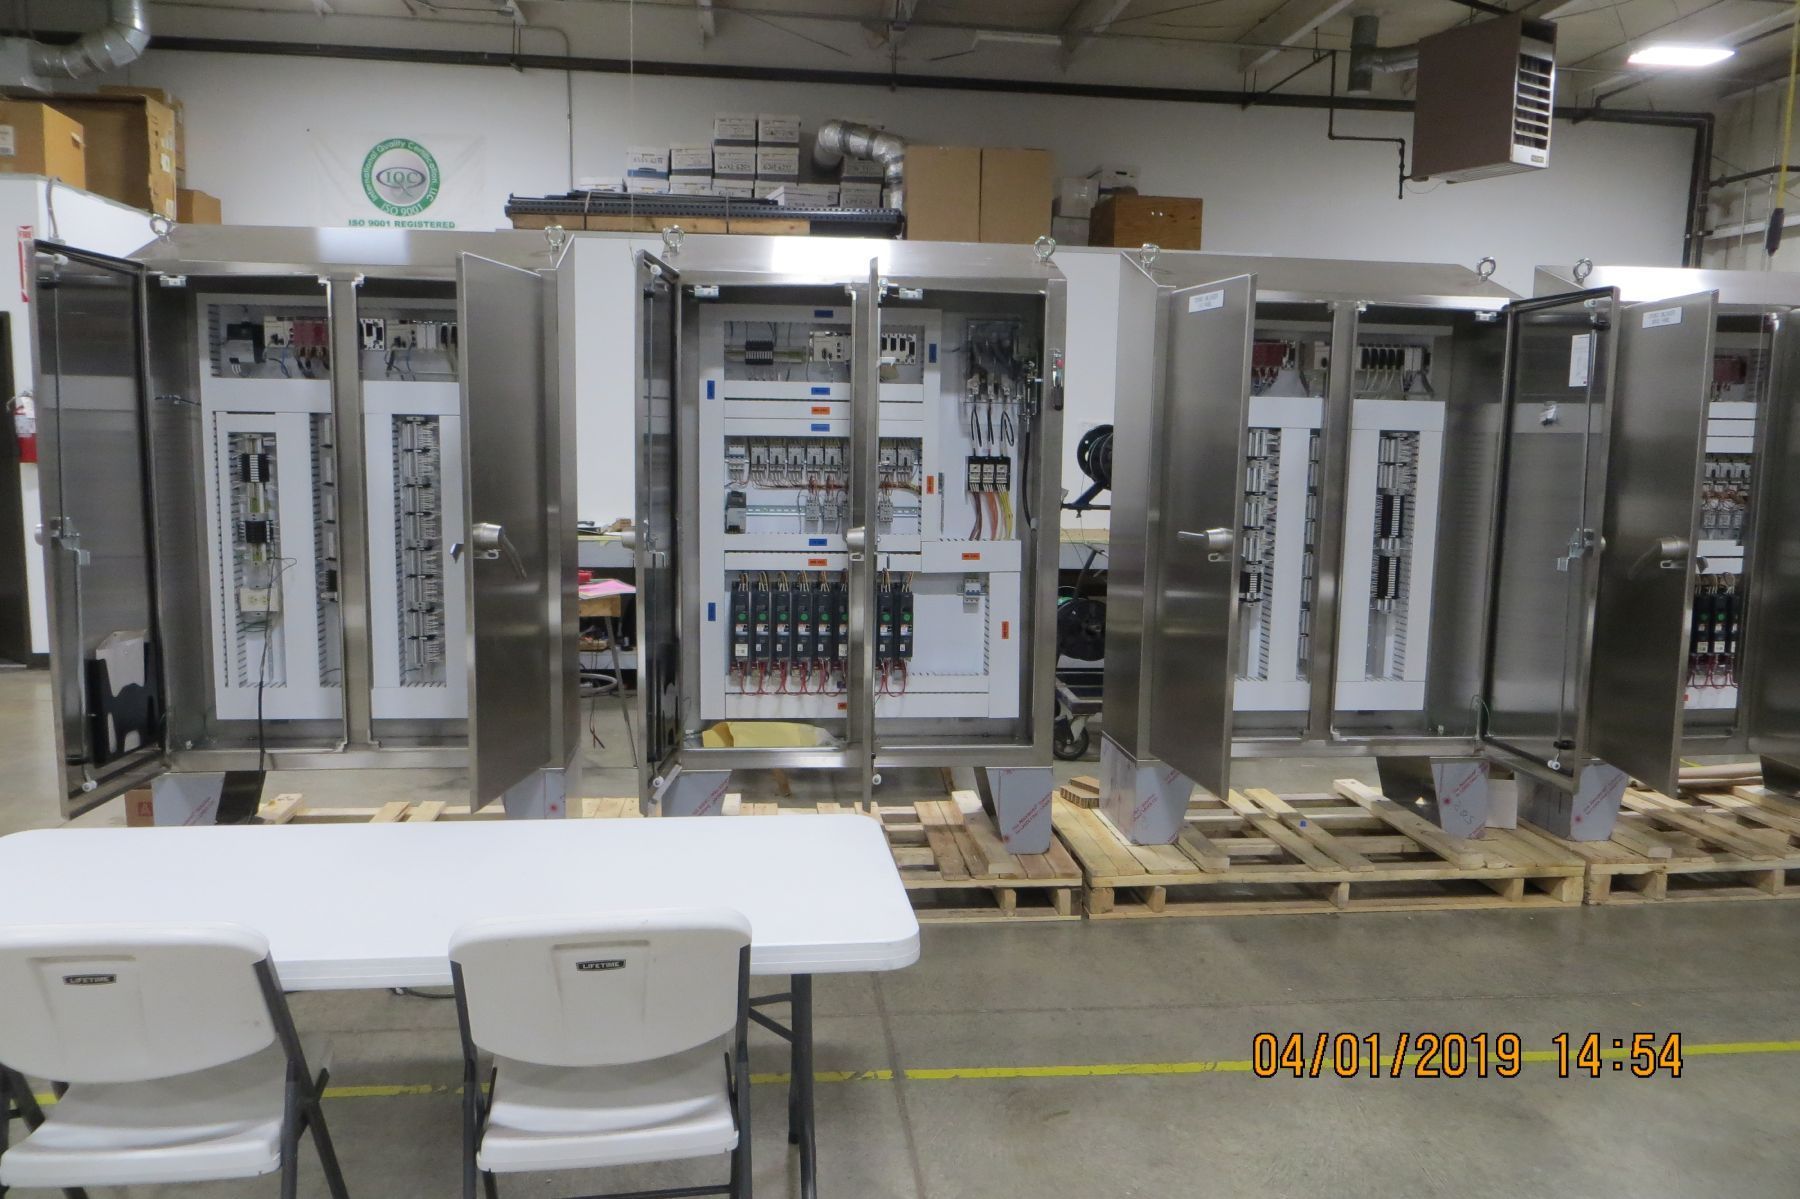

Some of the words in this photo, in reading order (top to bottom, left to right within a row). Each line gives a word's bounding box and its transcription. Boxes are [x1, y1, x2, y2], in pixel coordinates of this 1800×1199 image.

[363, 151, 378, 202] International
[376, 140, 405, 152] Quality
[426, 187, 438, 201] LLC
[386, 171, 420, 192] IQC
[381, 203, 399, 215] ISO
[401, 203, 423, 216] 9001
[348, 219, 365, 227] ISO
[394, 220, 455, 228] REGISTERED
[582, 961, 620, 969] LIFETIME
